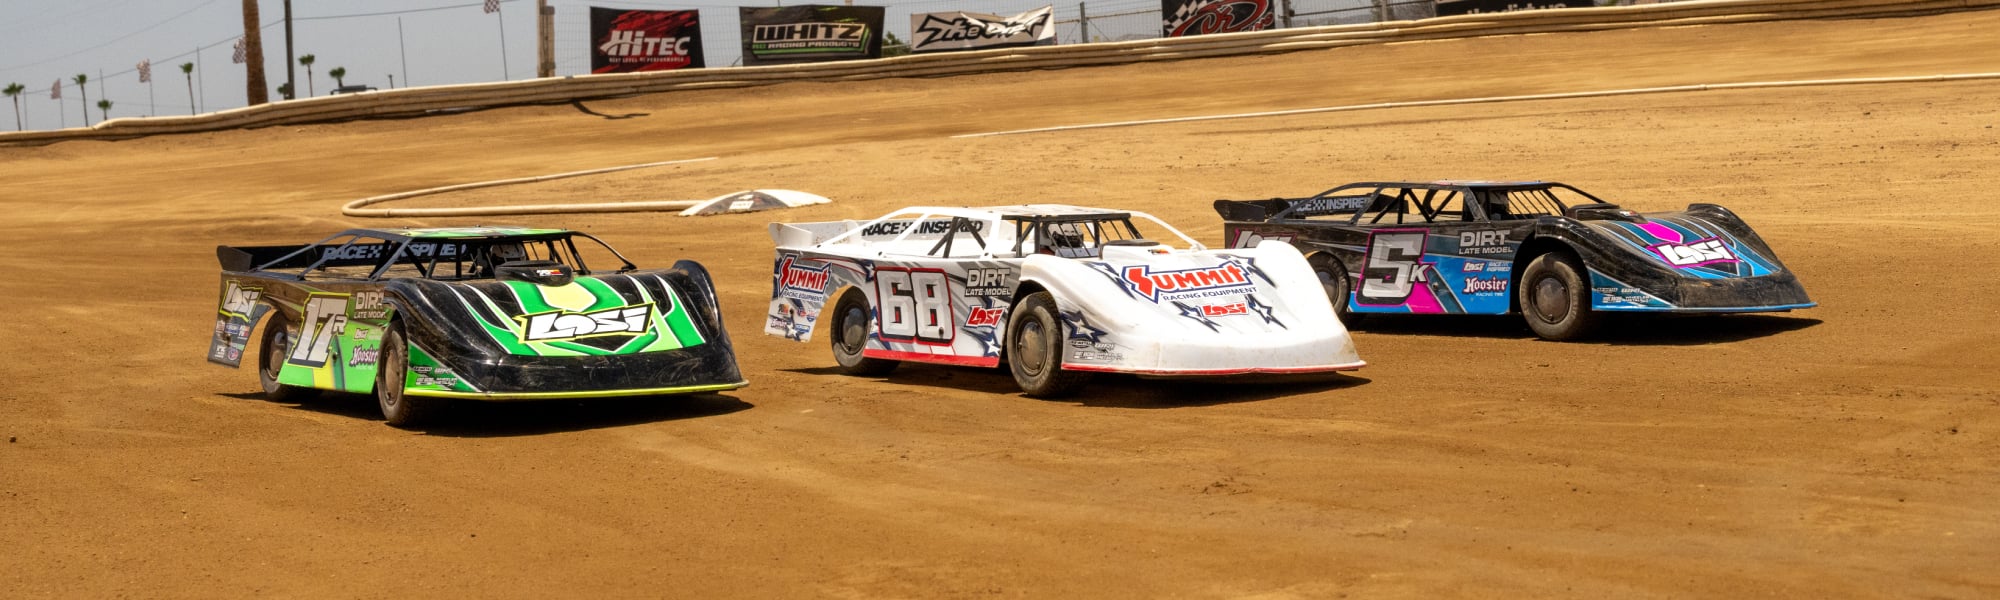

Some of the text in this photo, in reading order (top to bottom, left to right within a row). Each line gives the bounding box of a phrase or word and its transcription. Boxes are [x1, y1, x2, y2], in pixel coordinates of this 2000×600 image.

[757, 24, 862, 40] WHITZ
[862, 223, 900, 236] RACE
[1460, 230, 1510, 247] DIRT
[320, 245, 369, 259] RACE
[967, 269, 1010, 287] DIRT
[1463, 277, 1507, 293] Hoosier
[985, 288, 1011, 296] MODEL
[1163, 287, 1258, 301] RACING EQUIPMENT
[876, 270, 953, 338] 68
